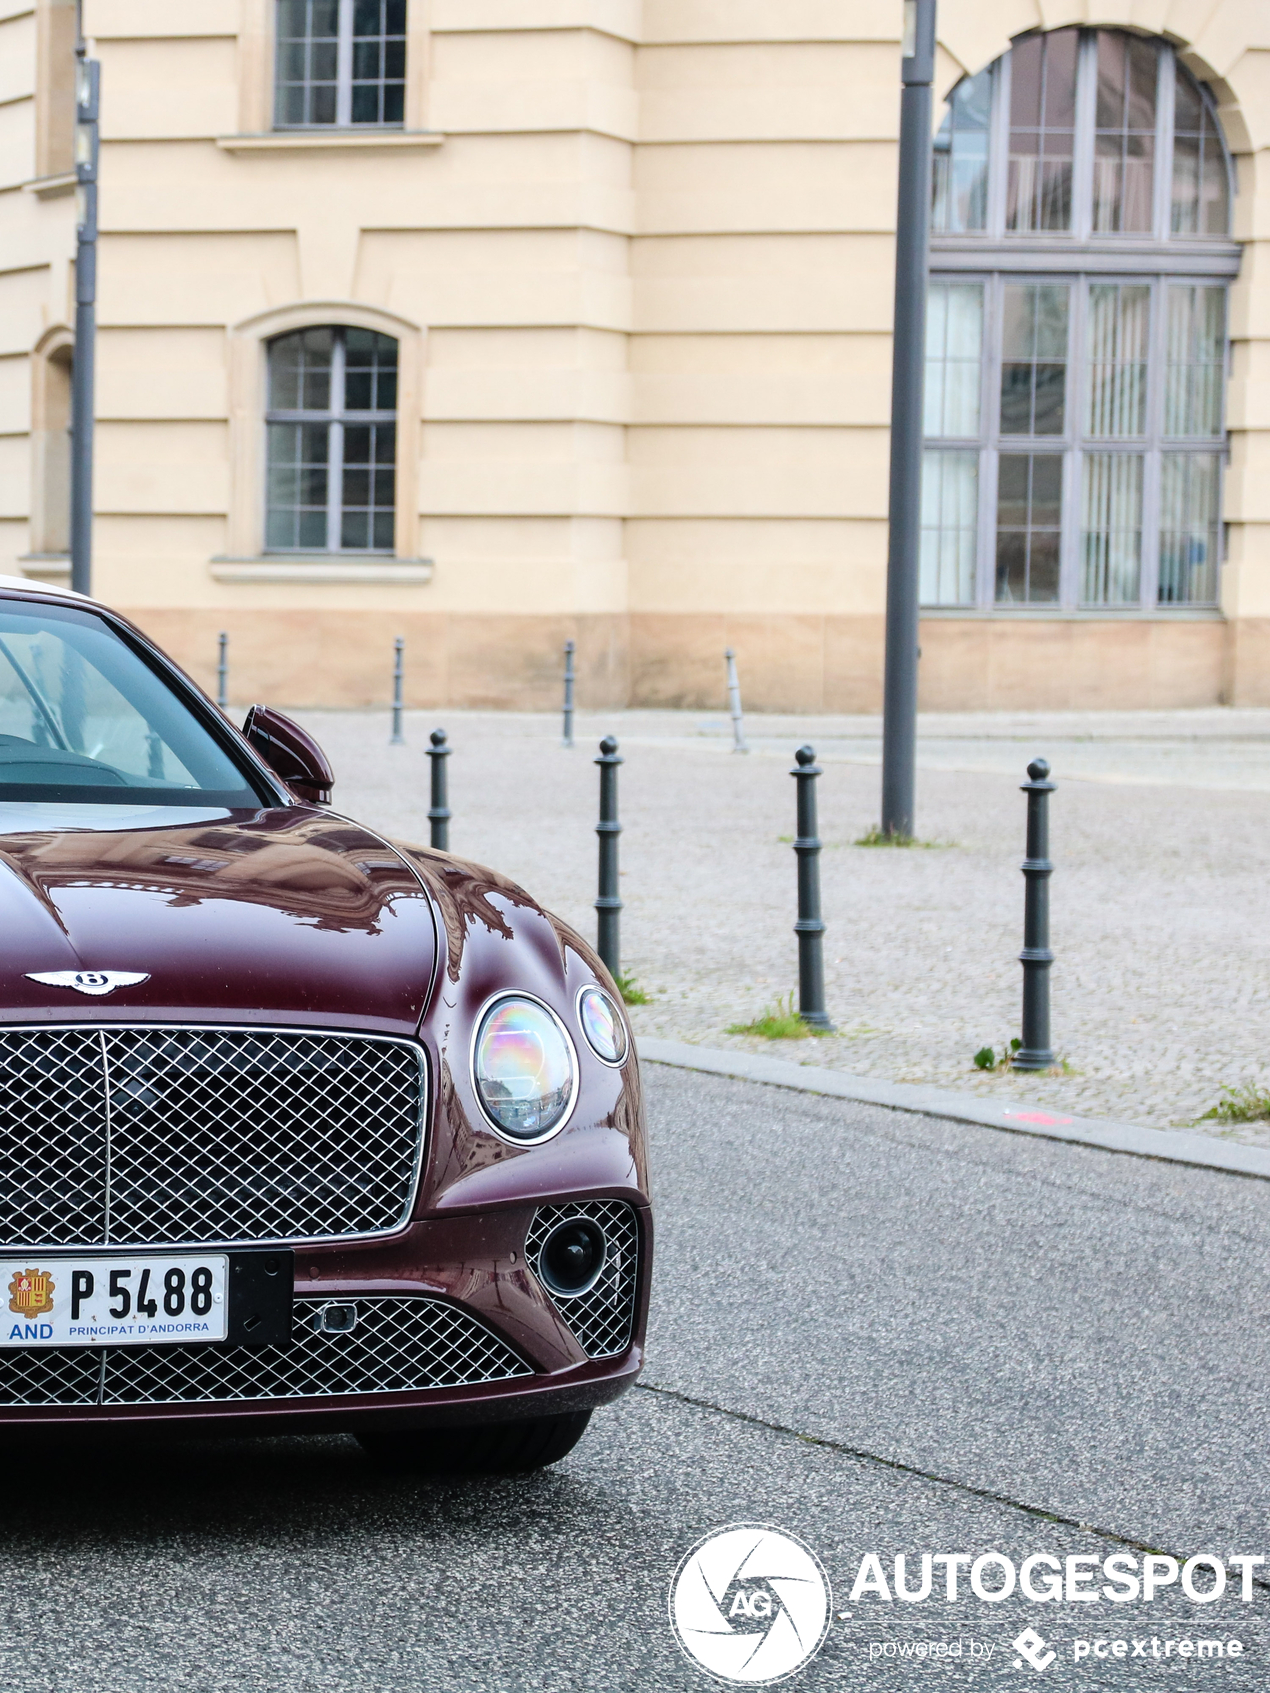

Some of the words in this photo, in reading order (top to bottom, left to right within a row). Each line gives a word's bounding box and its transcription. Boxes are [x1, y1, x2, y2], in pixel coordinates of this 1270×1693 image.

[71, 1270, 94, 1320] P
[109, 1267, 213, 1319] 5488
[9, 1323, 53, 1340] AND
[69, 1325, 135, 1336] PRINCIPAT
[138, 1322, 209, 1334] D'ANDORRA
